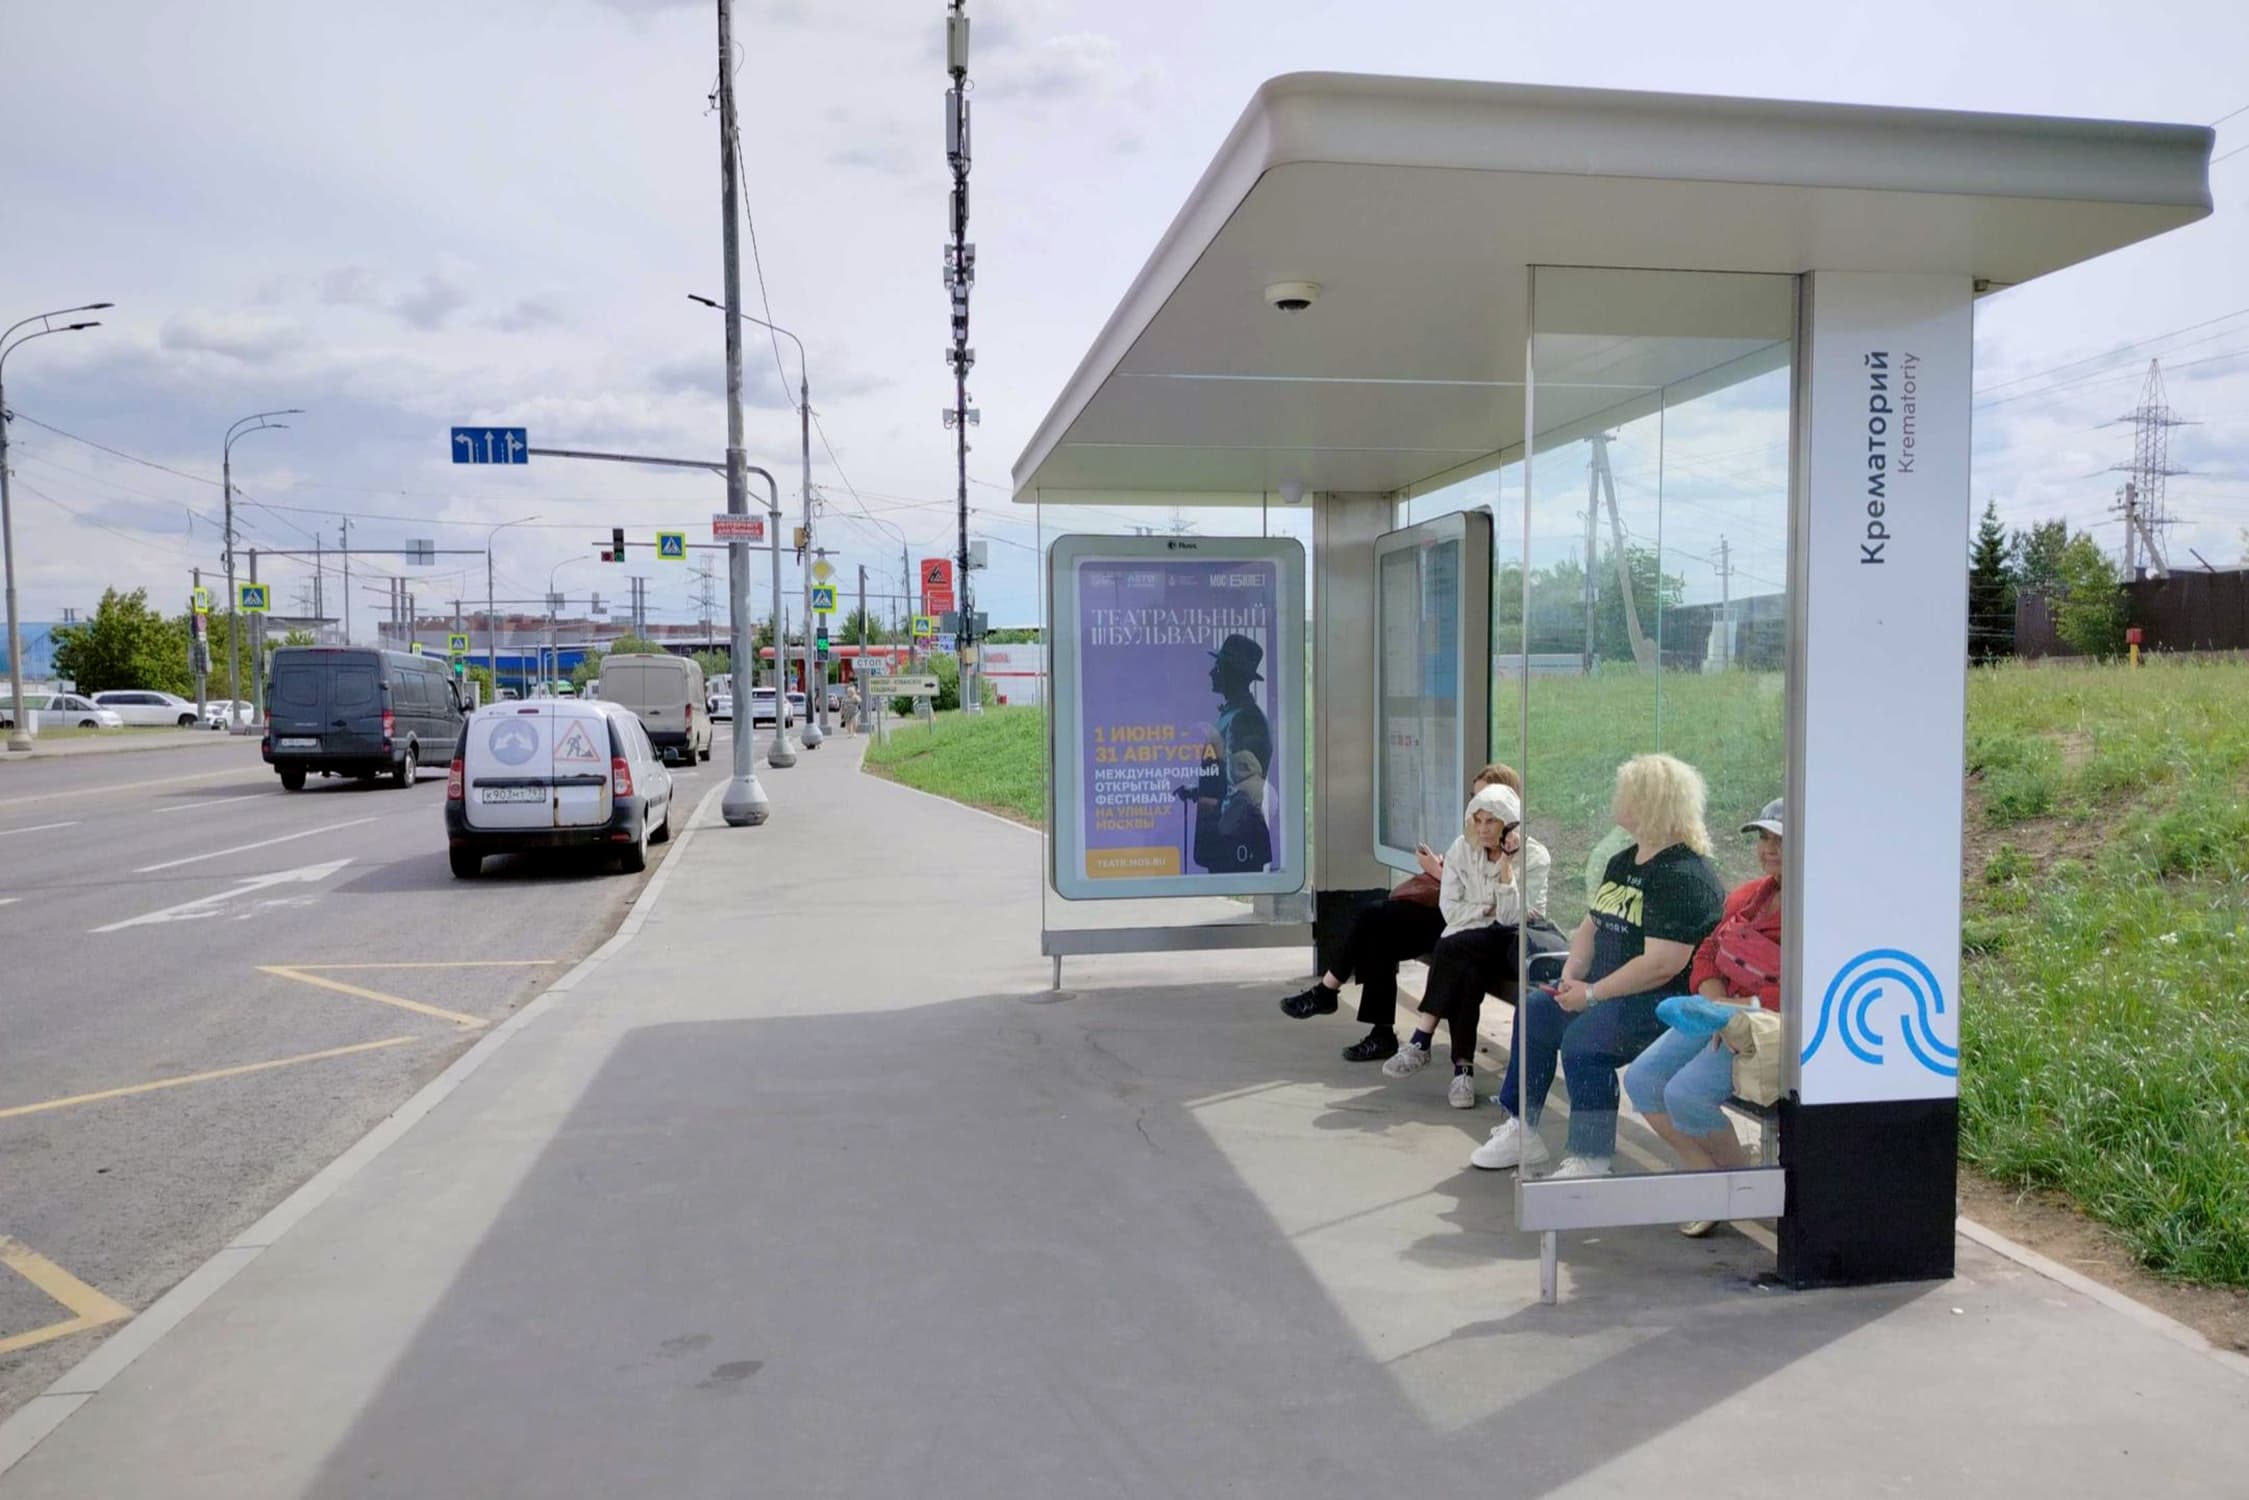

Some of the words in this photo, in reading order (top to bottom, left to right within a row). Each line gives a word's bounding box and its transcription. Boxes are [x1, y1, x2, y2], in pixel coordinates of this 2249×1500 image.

[1898, 351, 1921, 474] Krematoriy
[1860, 351, 1893, 564] Крематорий
[1091, 603, 1267, 627] ТЕАТРАЛЬНЫЙ
[1109, 626, 1211, 645] БУЛЬВАР
[1095, 726, 1105, 743] 1
[1110, 725, 1175, 743] ИЮНЯ
[1095, 746, 1118, 763] 31
[1123, 743, 1217, 763] АВГУСТА
[1094, 764, 1220, 780] МЕЖДУНАРОДНЫЙ
[1095, 779, 1171, 792] ОТКРЫТЫЙ
[1095, 793, 1176, 806] ФЕСТИВАЛЬ
[1096, 807, 1114, 818] НА
[1117, 805, 1173, 817] УЛИЦАХ
[1096, 818, 1155, 832] МОСКВЫ
